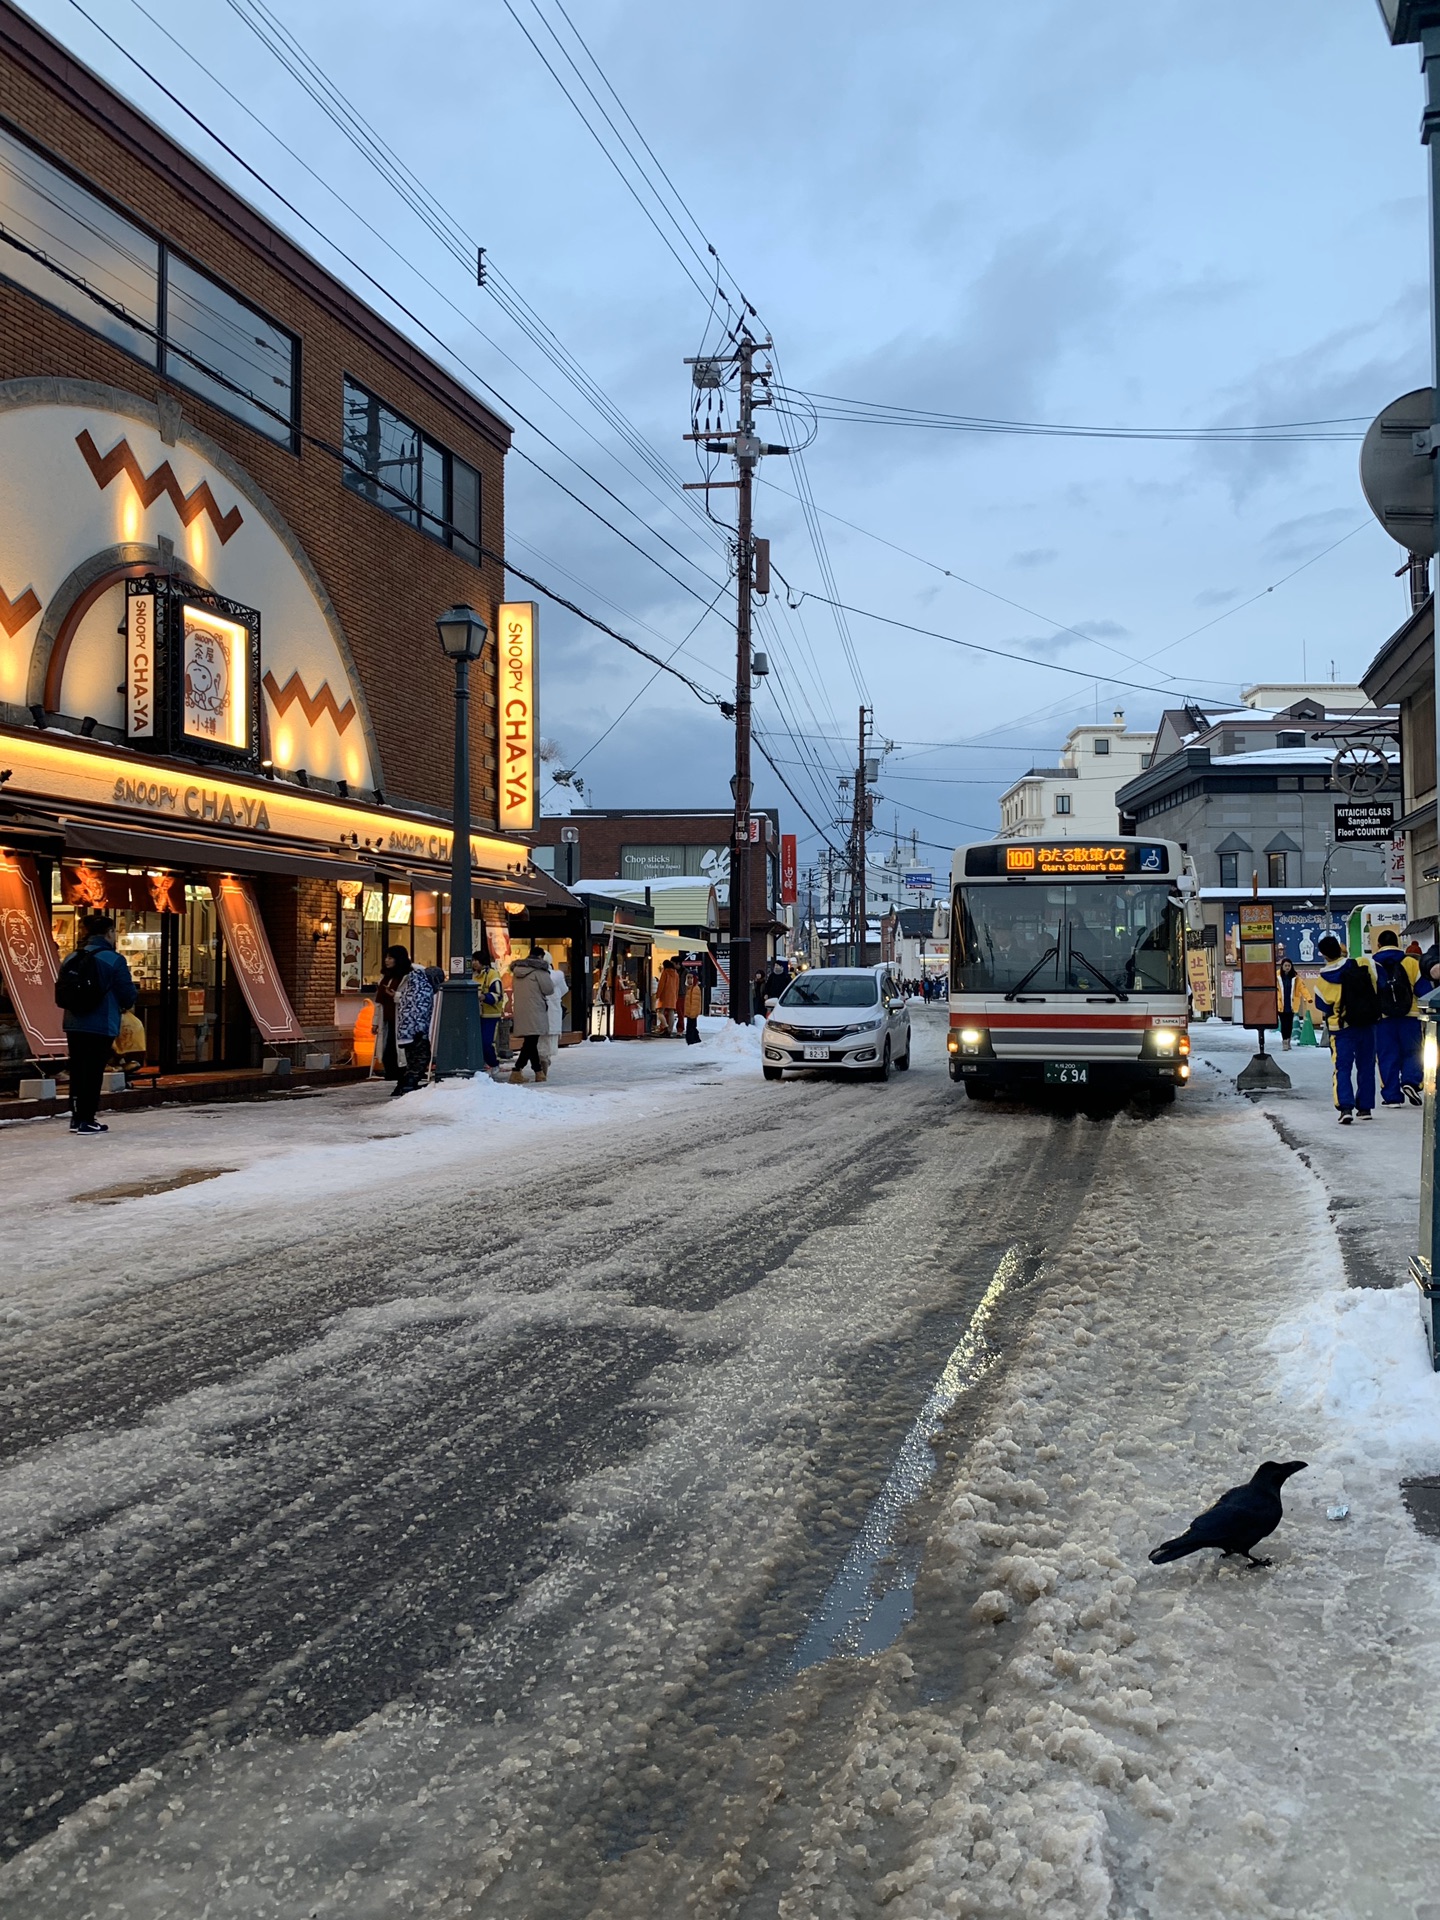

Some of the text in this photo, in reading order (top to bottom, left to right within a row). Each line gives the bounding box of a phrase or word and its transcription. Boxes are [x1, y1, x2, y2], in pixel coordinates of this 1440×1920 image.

[194, 632, 214, 646] SNOOPY
[194, 643, 215, 664] 茶屋
[133, 600, 149, 733] SNOOPY CHA-YA
[505, 621, 528, 811] SNOOPY CHA-YA
[192, 713, 217, 736] 小樽
[112, 776, 179, 809] SNOOPY
[1337, 807, 1392, 817] KITAICHI GLASS
[1347, 817, 1381, 827] Sangokan
[1337, 828, 1355, 837] Floor
[388, 831, 426, 854] SNOOPY
[624, 855, 670, 865] Chop sticks
[1009, 851, 1033, 867] 100
[1037, 848, 1126, 862] おたる散策バス
[1042, 863, 1123, 871] Otaru Stroller's Bus
[1377, 913, 1407, 922] 北一地酒
